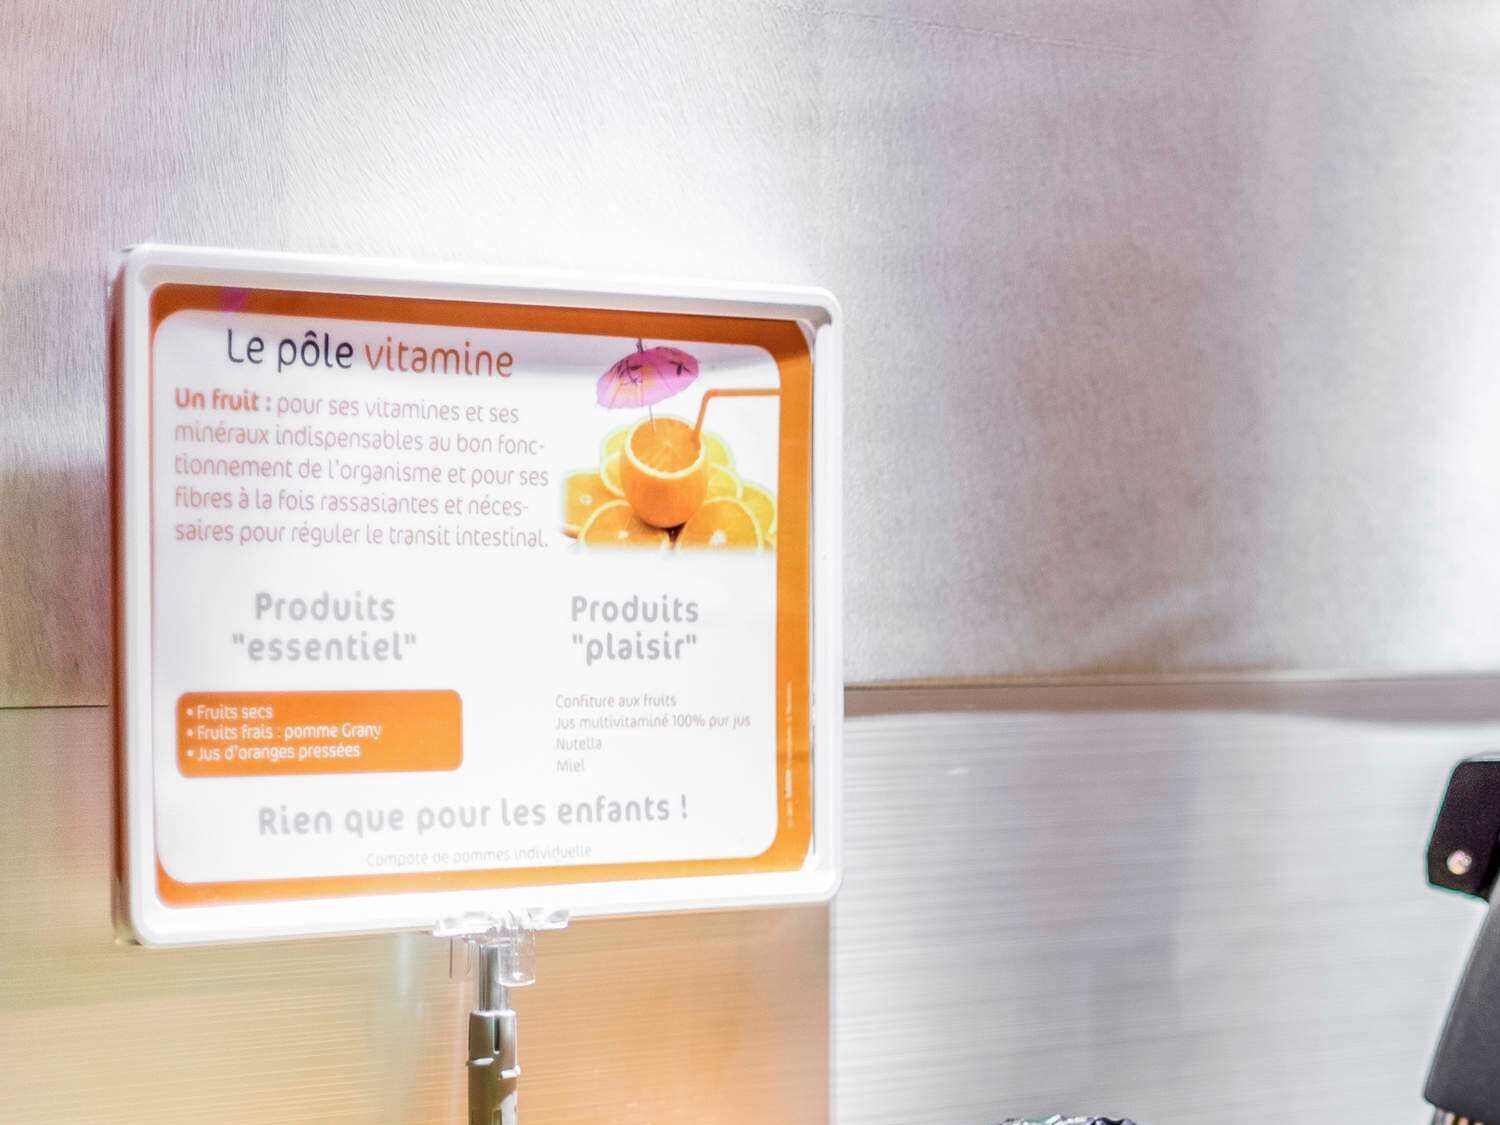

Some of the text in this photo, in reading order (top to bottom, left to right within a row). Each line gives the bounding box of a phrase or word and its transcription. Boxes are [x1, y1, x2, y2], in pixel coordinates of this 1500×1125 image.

[227, 328, 514, 378] Le pôle vitamine
[174, 388, 205, 412] Un
[212, 388, 259, 413] fruit
[277, 396, 322, 418] pour
[328, 398, 360, 417] ses
[365, 395, 460, 422] vitamines
[465, 403, 484, 423] et
[489, 405, 519, 424] ses
[174, 420, 545, 456] minéraux indispensables au bon fonc-
[174, 453, 549, 489] tionnement de l'organisme et pour ses
[174, 486, 529, 517] fibres à la fois rassasiantes et néces-
[174, 518, 549, 549] saires pour réguler le transit intestinal.
[254, 590, 397, 623] Produits
[570, 594, 700, 624] Produits
[231, 631, 418, 664] "essentiel"
[571, 631, 698, 667] "plaisir"
[197, 704, 273, 720] Fruits secs
[555, 693, 677, 709] Confiture aux fruits
[197, 725, 238, 741] Fruits
[241, 724, 273, 740] frais
[284, 724, 338, 741] pomme
[341, 721, 383, 741] Grany
[555, 716, 576, 731] Jus
[672, 713, 706, 728] 100%
[709, 715, 729, 730] pur
[732, 713, 752, 730] jus
[197, 743, 360, 763] Jus d'oranges pressées
[556, 737, 603, 751] Nutella
[556, 758, 586, 774] Miel
[257, 793, 690, 839] Rien que pour les enfants !
[365, 844, 592, 868] Compote de pommes individuelle
